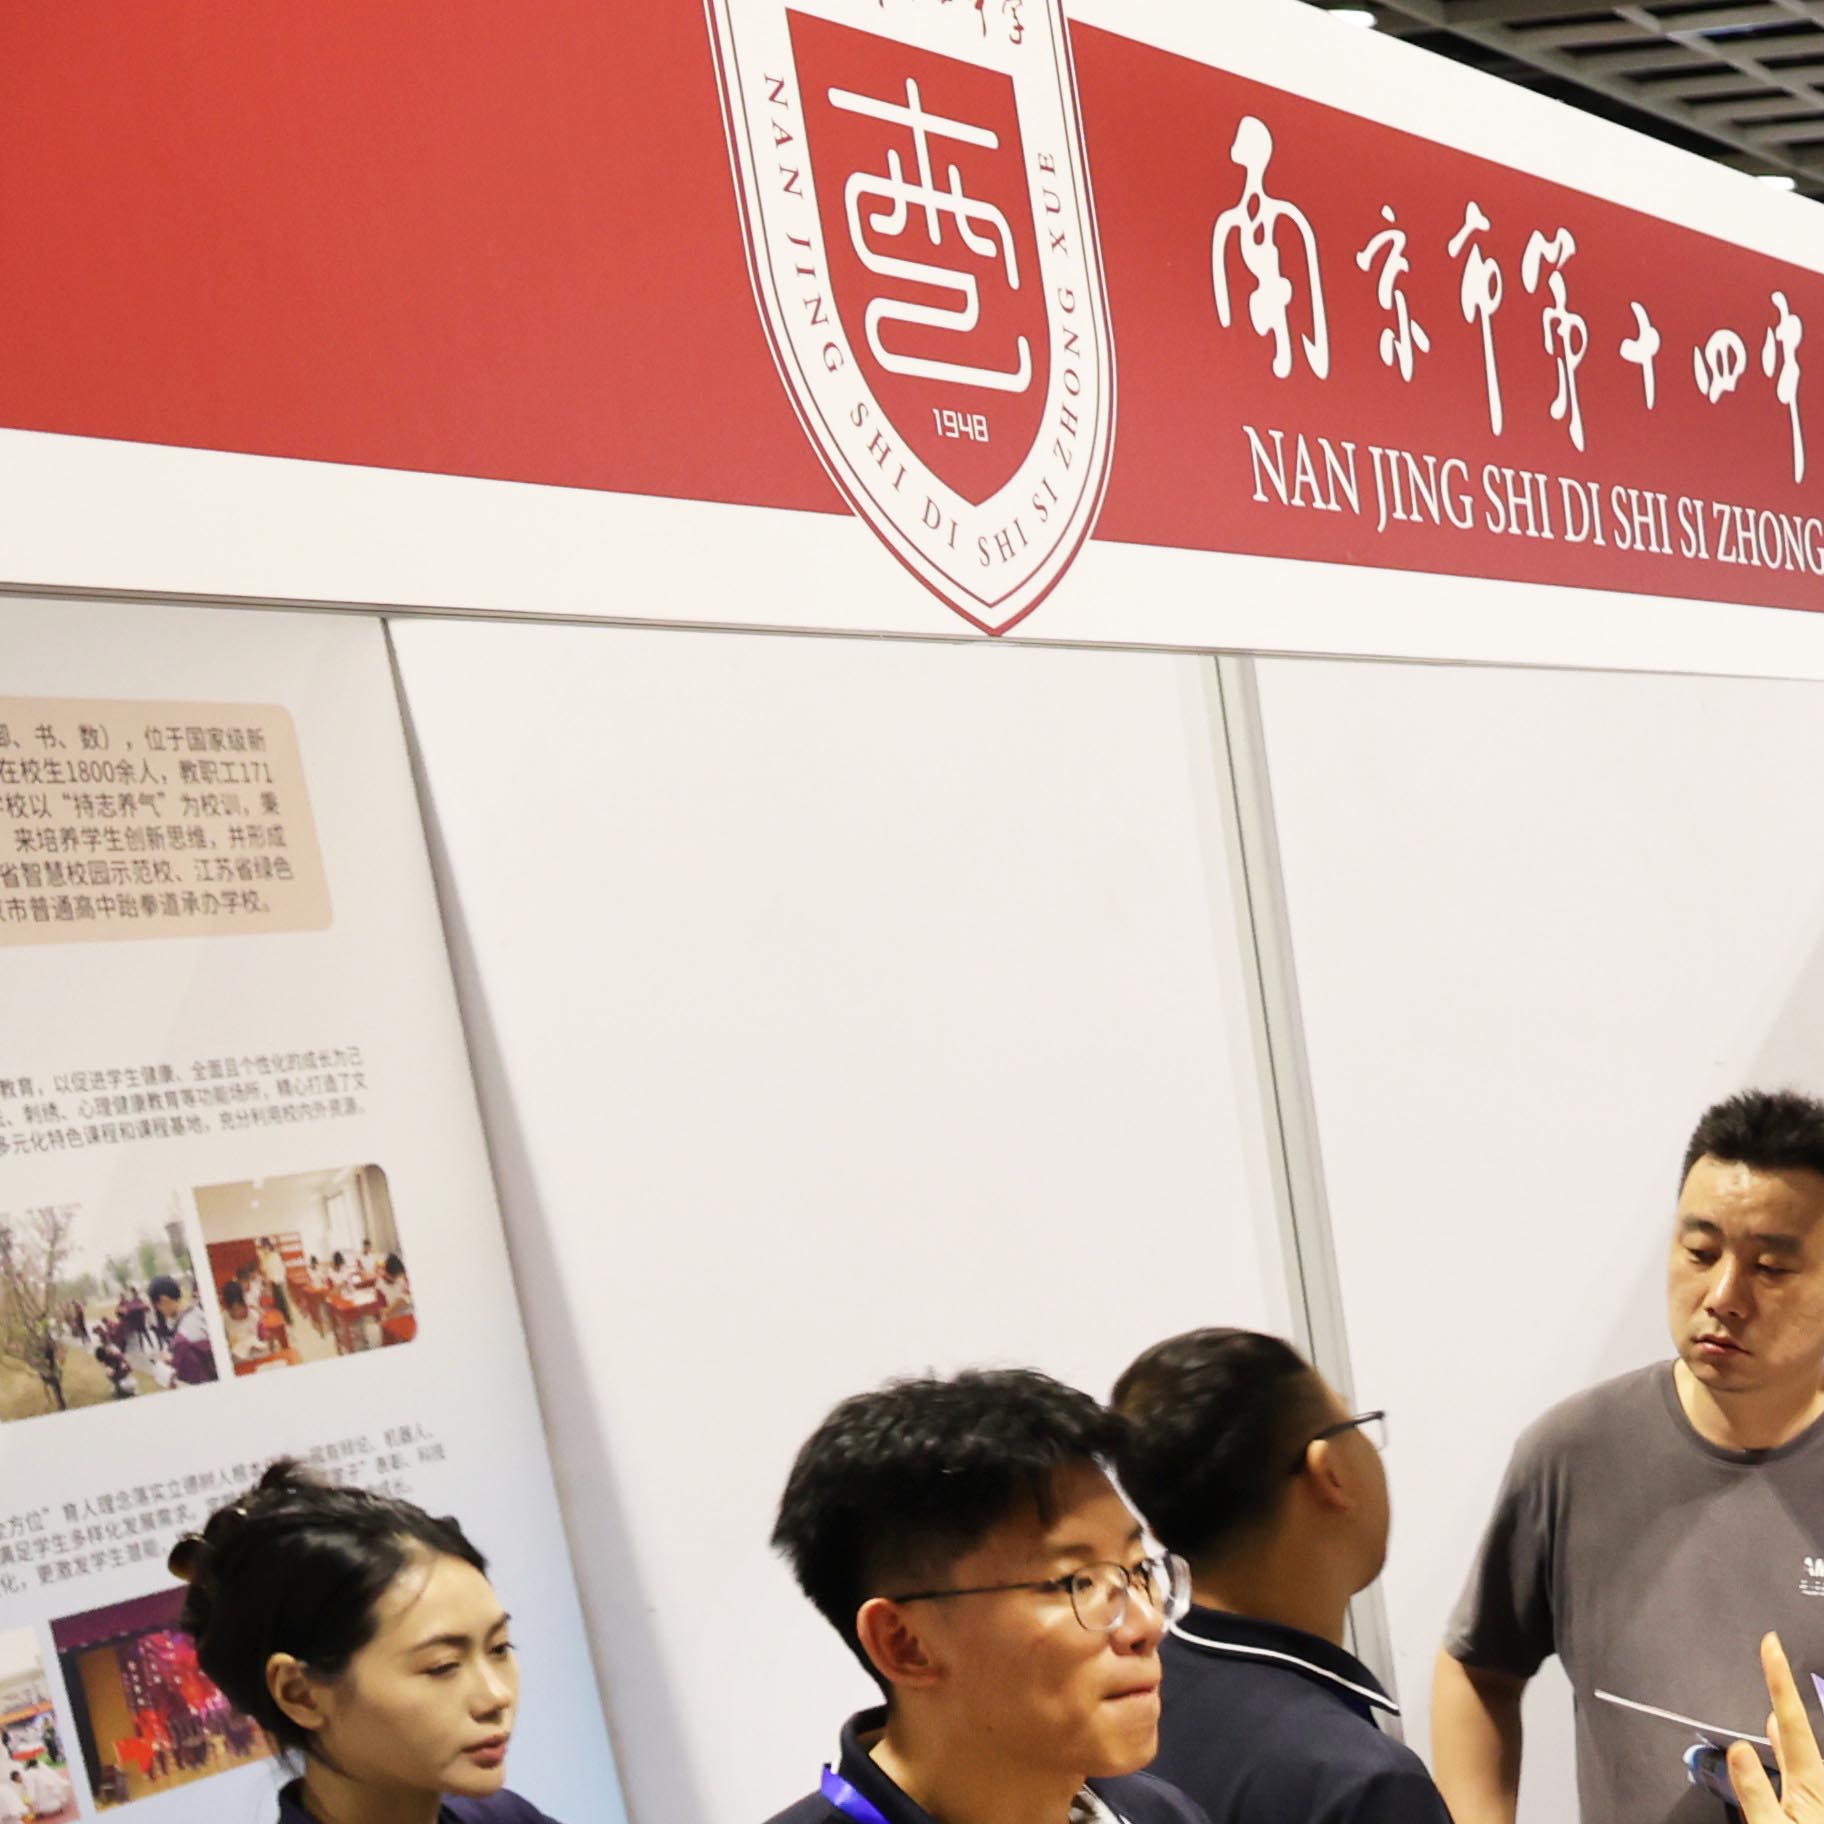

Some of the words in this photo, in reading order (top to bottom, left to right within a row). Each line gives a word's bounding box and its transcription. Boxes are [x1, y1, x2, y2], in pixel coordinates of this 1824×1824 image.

[764, 73, 803, 199] NAN
[1038, 152, 1069, 256] XUE
[786, 232, 845, 373] JING
[932, 408, 989, 442] 1948
[1053, 287, 1081, 471] ZHONG
[849, 402, 907, 492] SHI
[1242, 425, 1360, 515] NAN
[1367, 446, 1474, 533] JING
[1482, 464, 1555, 539] SHI
[1558, 476, 1606, 546] DI
[1611, 485, 1673, 555] SHI
[1678, 497, 1710, 559] SI
[920, 496, 958, 549] DI
[977, 519, 1029, 567] SHI
[1031, 477, 1059, 522] SI
